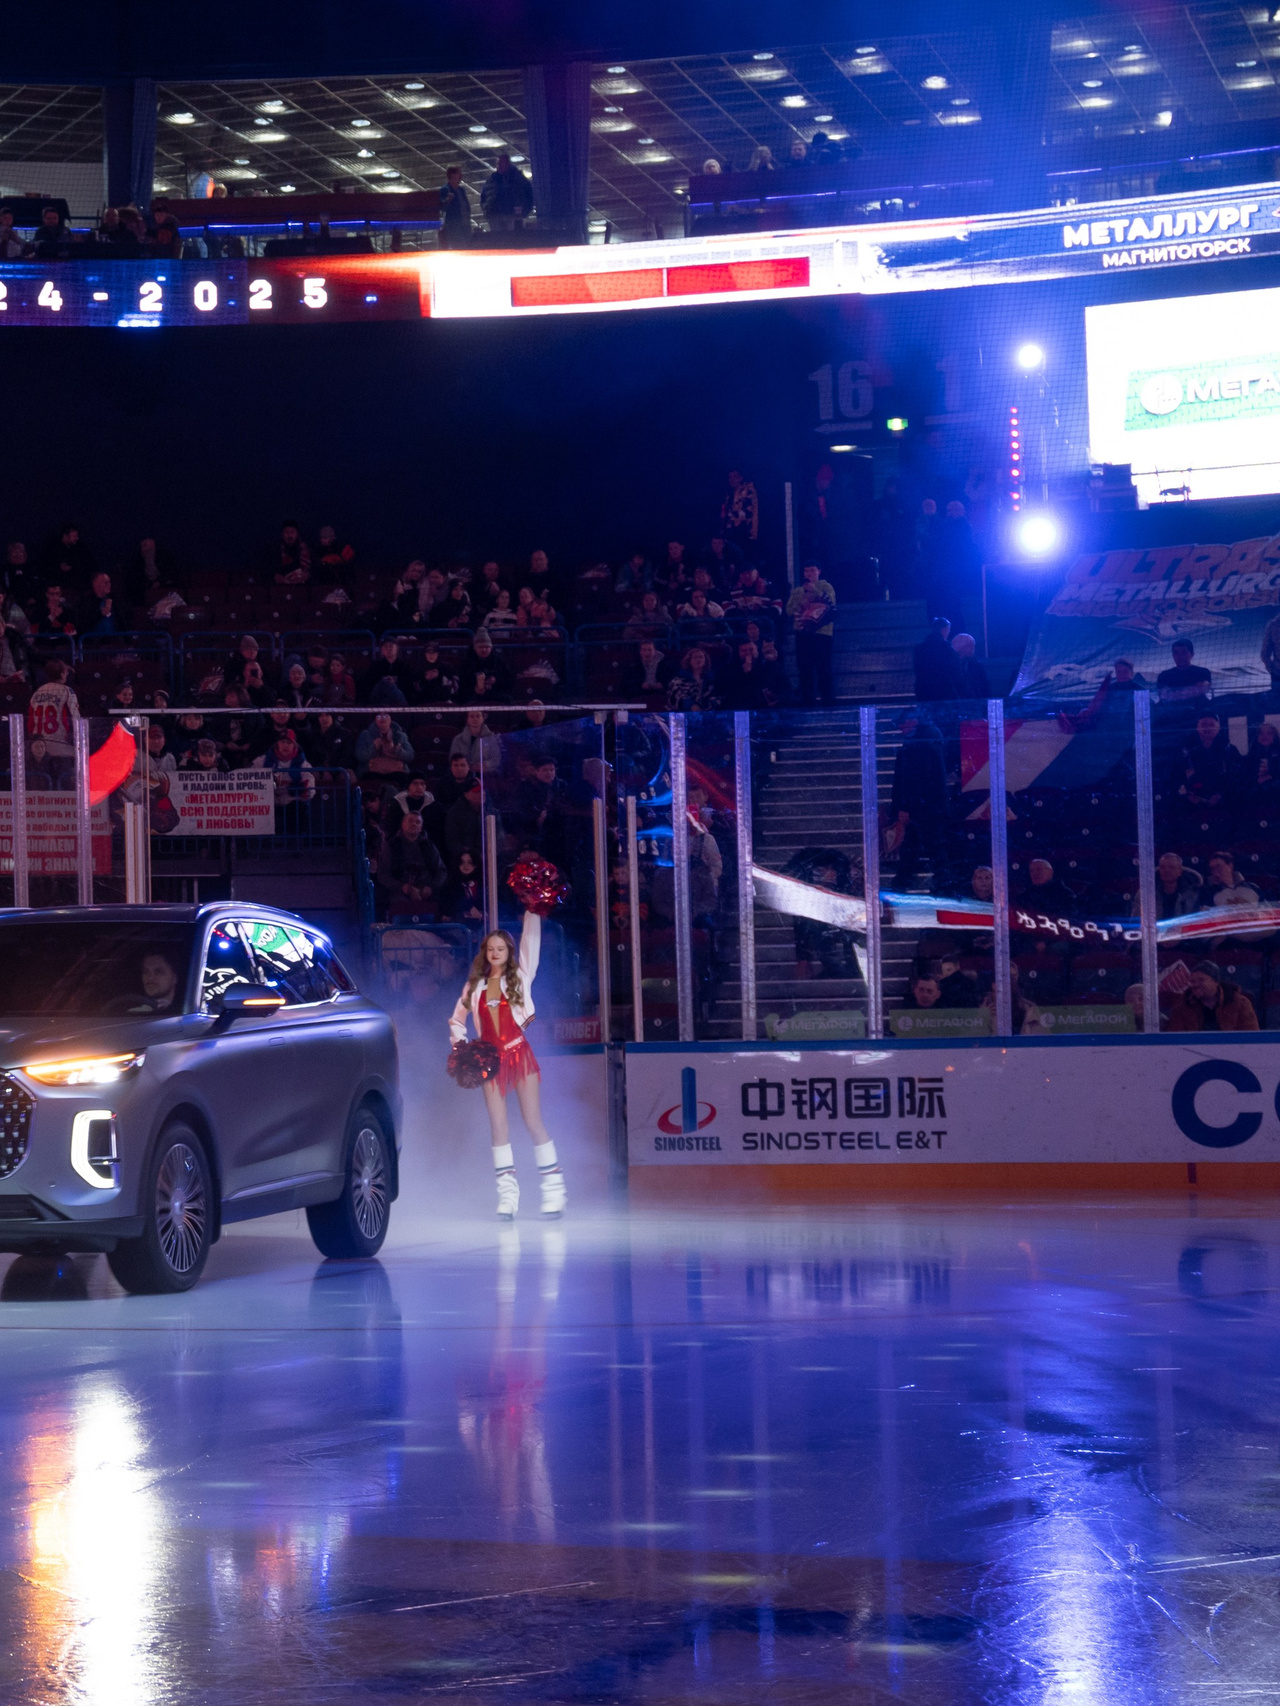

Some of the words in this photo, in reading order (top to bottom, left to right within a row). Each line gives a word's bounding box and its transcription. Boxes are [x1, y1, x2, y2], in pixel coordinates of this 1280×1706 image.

[1063, 204, 1259, 248] МЕТАЛЛУРГ
[1102, 238, 1251, 268] МАГНИТОГОРСК
[808, 360, 874, 420] 16
[1066, 537, 1280, 583] ULTRAS
[35, 705, 58, 735] 18
[178, 772, 205, 782] ПУСТЬ
[207, 772, 235, 781] ГОЛОС
[237, 771, 271, 781] СОРВАН
[190, 783, 226, 792] ЛАДОНИ
[228, 783, 234, 791] В
[236, 781, 267, 790] КРОВЬ:
[185, 793, 259, 804] «МЕТАЛЛУРГУ»
[180, 806, 204, 817] ВСЮ
[206, 805, 271, 817] ПОДДЕРЖКУ
[196, 820, 203, 829] И
[206, 818, 255, 829] ЛЮБОВЬ!
[740, 1076, 948, 1121] 中钢国际
[654, 1136, 723, 1152] SINOSTEEL
[742, 1131, 891, 1151] SINOSTEEL
[896, 1130, 948, 1150] E&T
